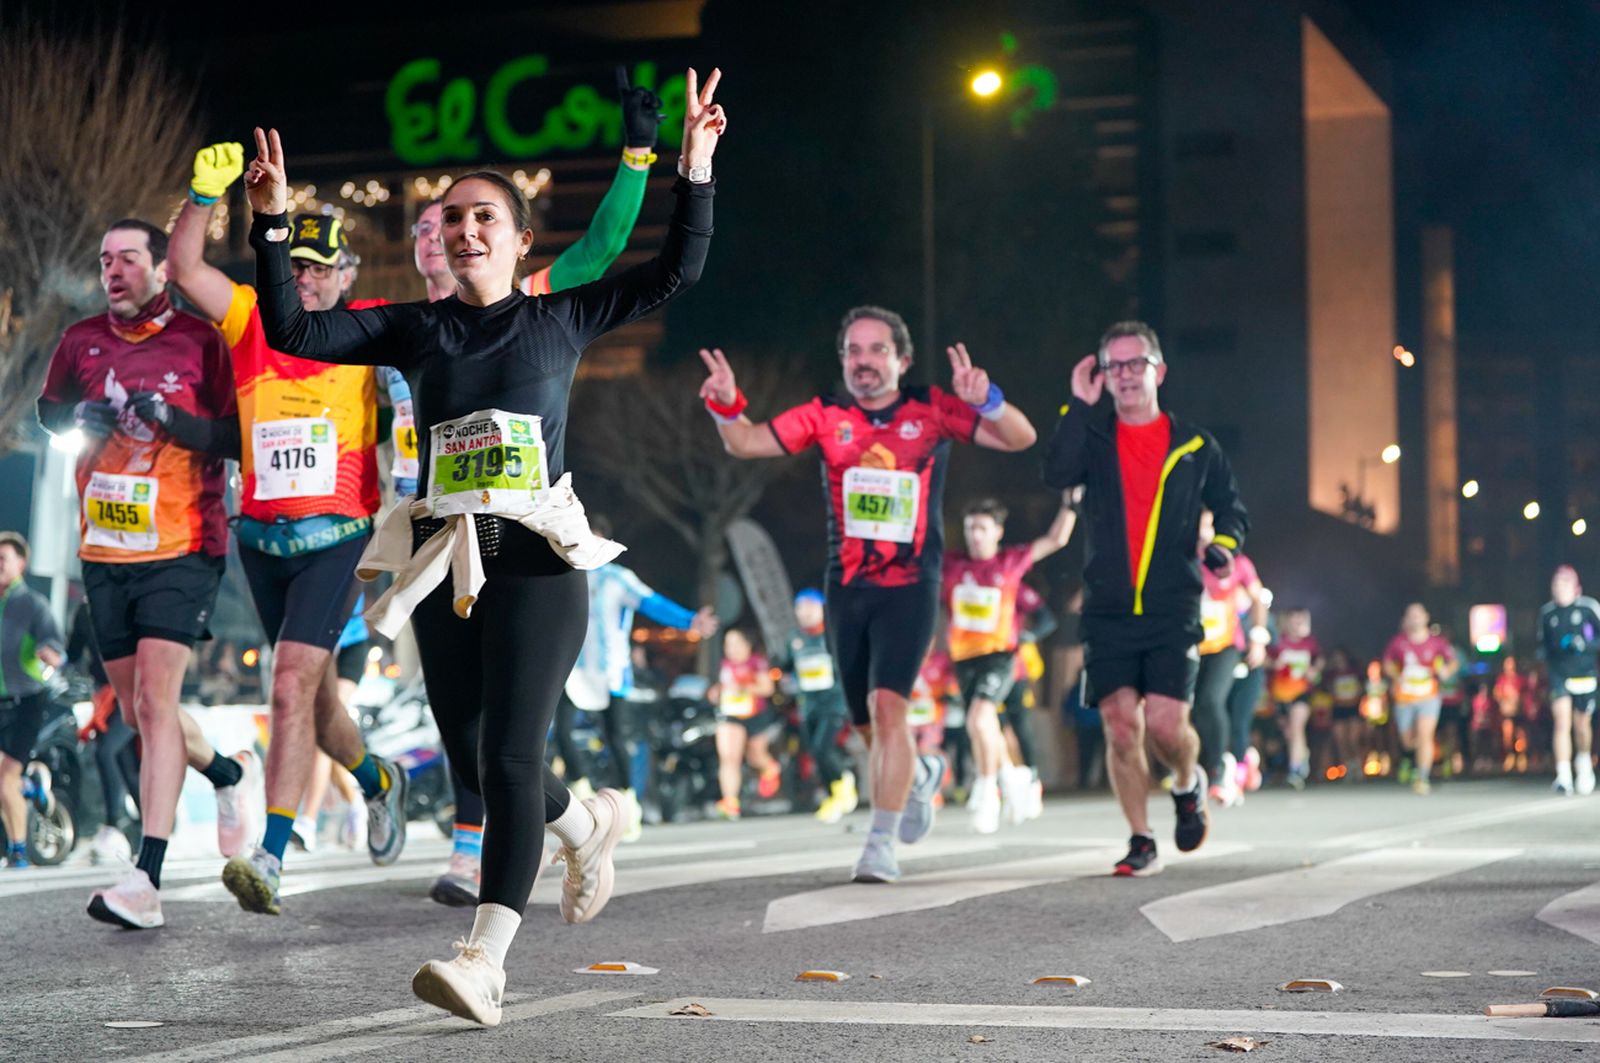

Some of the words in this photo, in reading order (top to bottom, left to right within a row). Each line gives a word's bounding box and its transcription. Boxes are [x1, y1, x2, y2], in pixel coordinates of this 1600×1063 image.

[384, 57, 480, 164] El
[455, 422, 489, 439] NOCHE
[445, 439, 466, 454] SAN
[270, 447, 316, 471] 4176
[452, 446, 522, 481] 3195
[96, 500, 139, 525] 7455
[856, 494, 902, 518] 457
